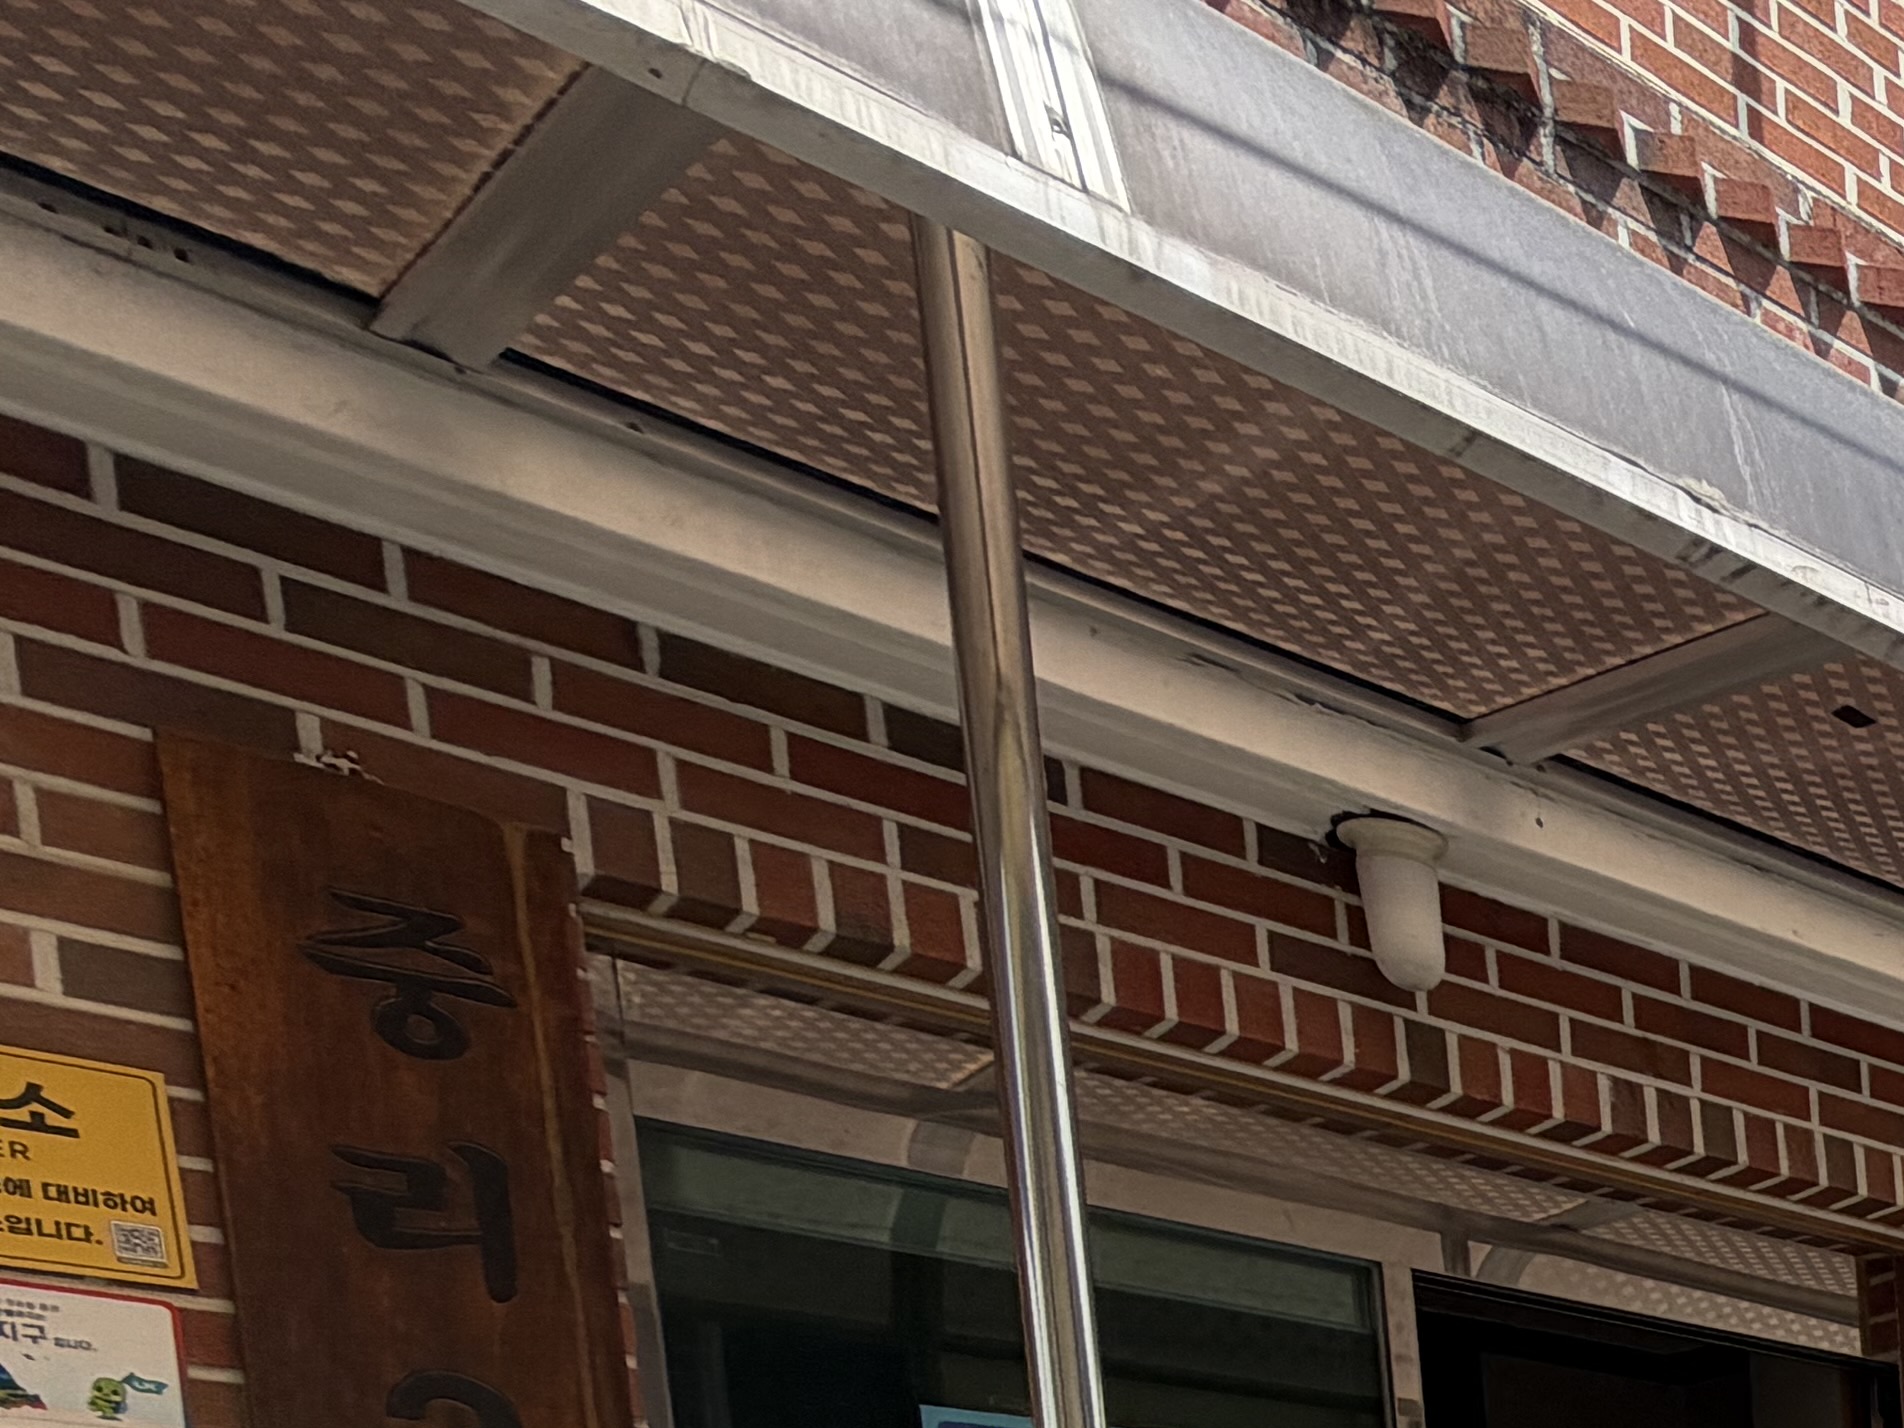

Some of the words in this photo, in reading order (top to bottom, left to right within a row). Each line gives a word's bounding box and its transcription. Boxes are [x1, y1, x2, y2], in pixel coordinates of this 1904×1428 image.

[0, 1140, 31, 1161] R
[0, 1176, 34, 1200] 에
[41, 1181, 158, 1217] 대비하여
